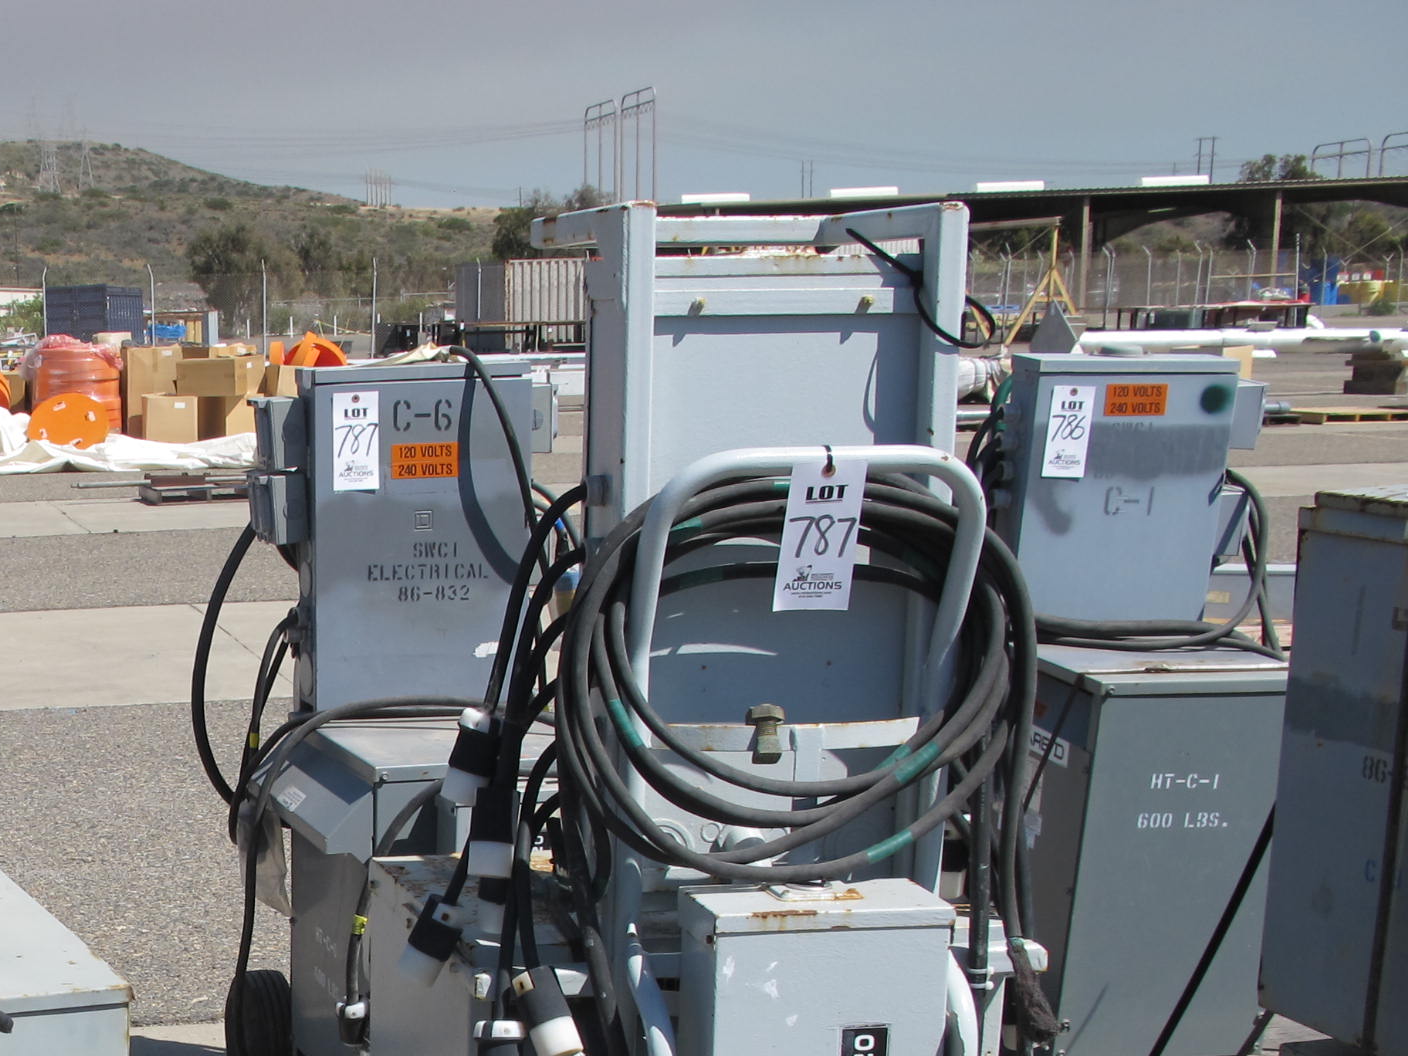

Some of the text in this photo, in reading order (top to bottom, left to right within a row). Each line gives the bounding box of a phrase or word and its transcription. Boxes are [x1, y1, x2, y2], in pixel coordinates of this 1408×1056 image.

[1113, 385, 1162, 398] 120 VOLTS
[344, 408, 368, 418] LOT
[1061, 401, 1085, 411] LOT
[1110, 402, 1161, 414] 240 VOLTS
[393, 399, 452, 431] C-6
[1051, 413, 1087, 442] 786
[334, 422, 380, 459] 787
[399, 445, 452, 459] 120 VOLTS
[339, 470, 374, 478] AUCTIONS
[398, 463, 453, 477] 240 VOLTS
[805, 485, 849, 501] LOT
[788, 514, 858, 559] 787
[367, 562, 489, 582] ELECTRICAL
[398, 585, 471, 602] 86-832
[783, 581, 843, 591] AUCTIONS
[1137, 812, 1229, 829] 600 LBS.
